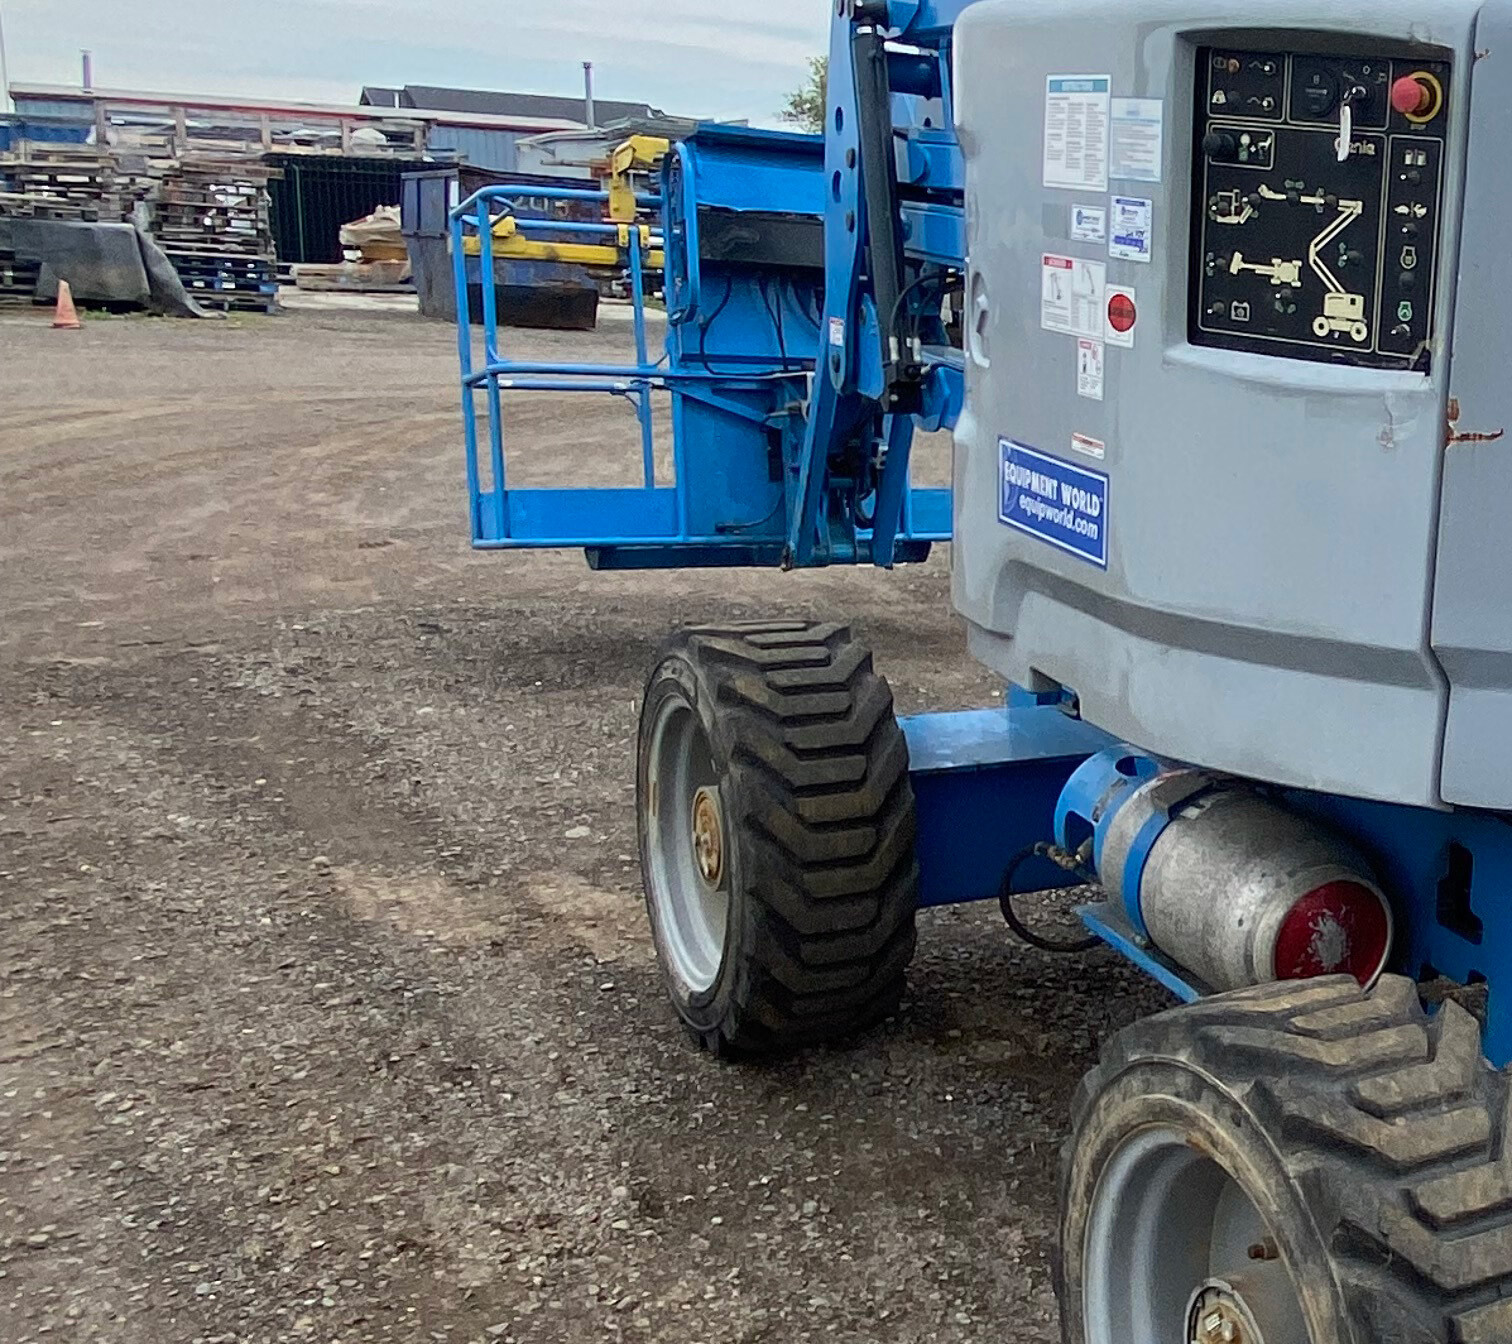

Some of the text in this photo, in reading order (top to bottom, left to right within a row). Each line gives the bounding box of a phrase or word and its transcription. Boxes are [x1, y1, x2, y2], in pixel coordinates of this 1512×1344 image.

[1004, 460, 1100, 517] EQUIPMENT WORLD
[1019, 494, 1098, 540] equipworld.com
